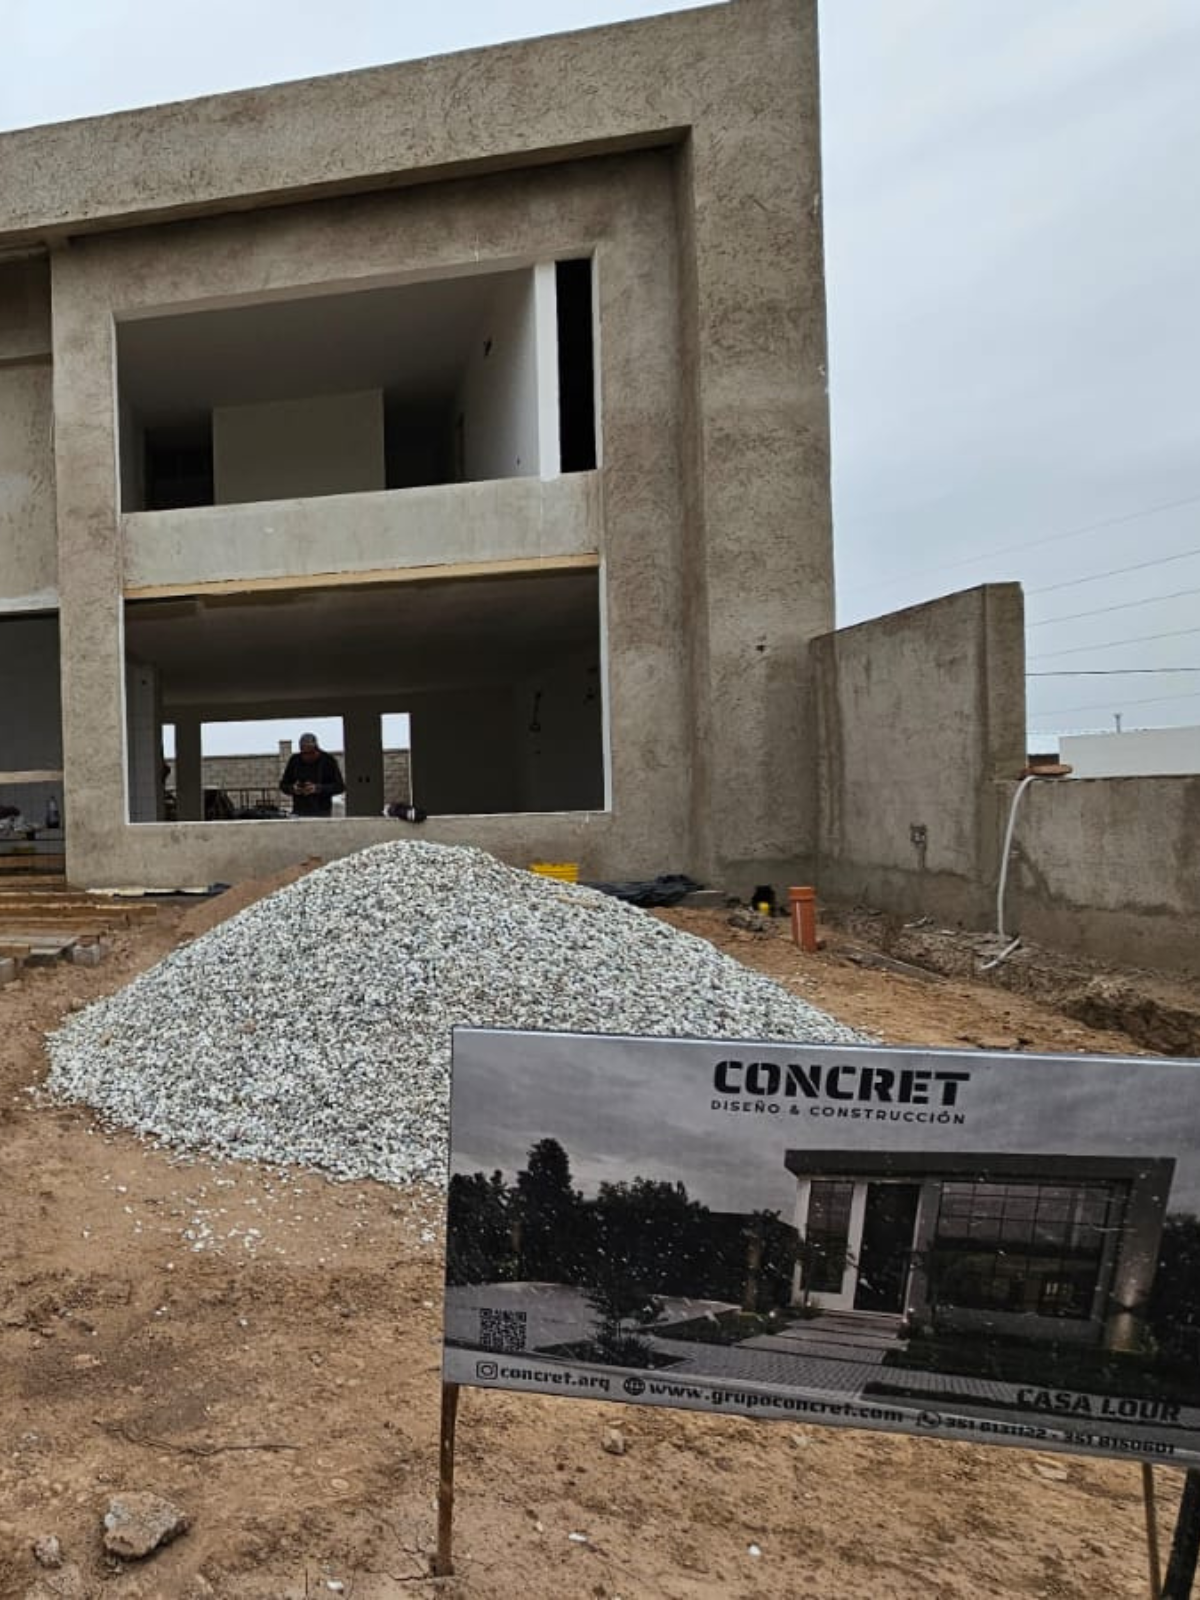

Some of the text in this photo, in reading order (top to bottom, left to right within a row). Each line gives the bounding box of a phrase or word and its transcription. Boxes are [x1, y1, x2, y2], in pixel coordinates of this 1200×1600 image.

[714, 1060, 971, 1106] CONCRET
[711, 1100, 966, 1125] DISEÑO & CONSTRUCCIÓN
[500, 1367, 611, 1392] concret.arq
[649, 1382, 904, 1423] www.grupoconcret.com
[1016, 1388, 1181, 1422] CASA LOUR
